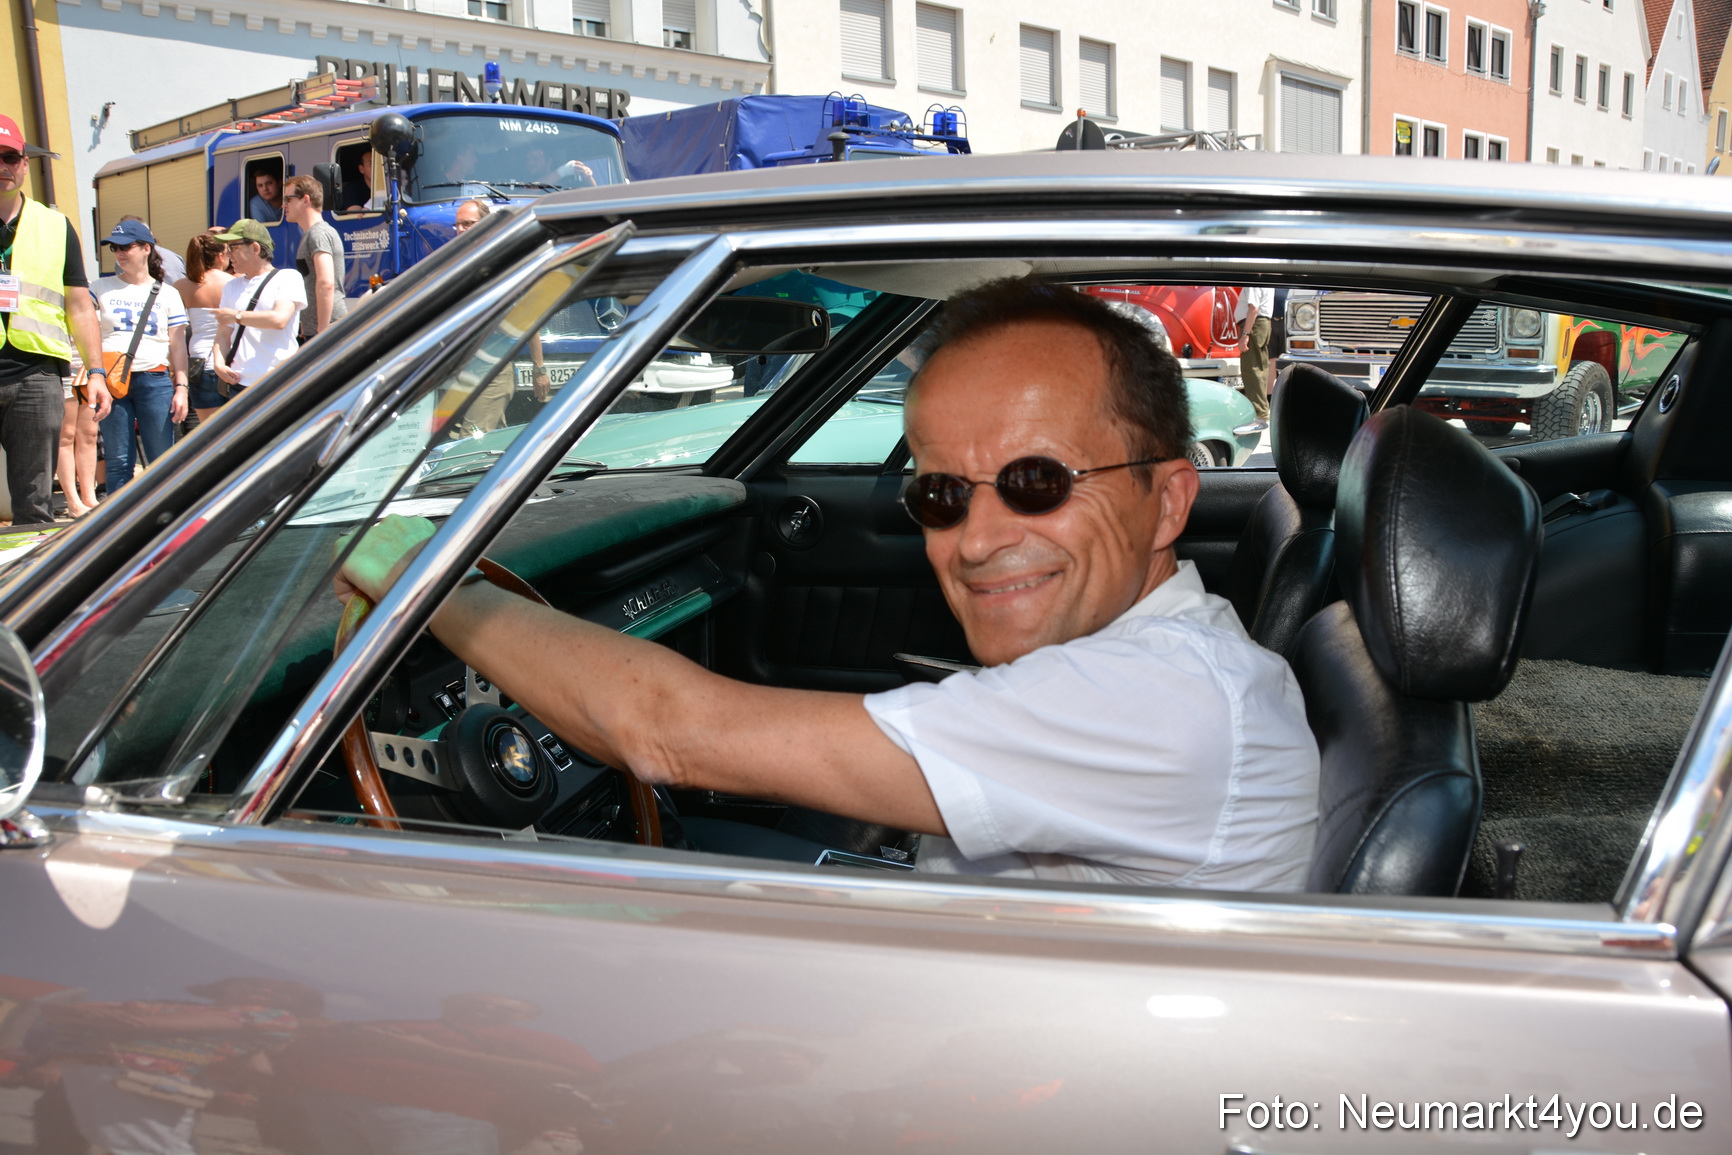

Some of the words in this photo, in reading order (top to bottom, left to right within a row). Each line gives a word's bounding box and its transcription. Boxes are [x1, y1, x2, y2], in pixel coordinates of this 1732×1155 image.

[498, 75, 631, 117] WEBER
[499, 119, 522, 132] NM
[343, 231, 379, 241] Technisches
[109, 299, 161, 309] COWBOS
